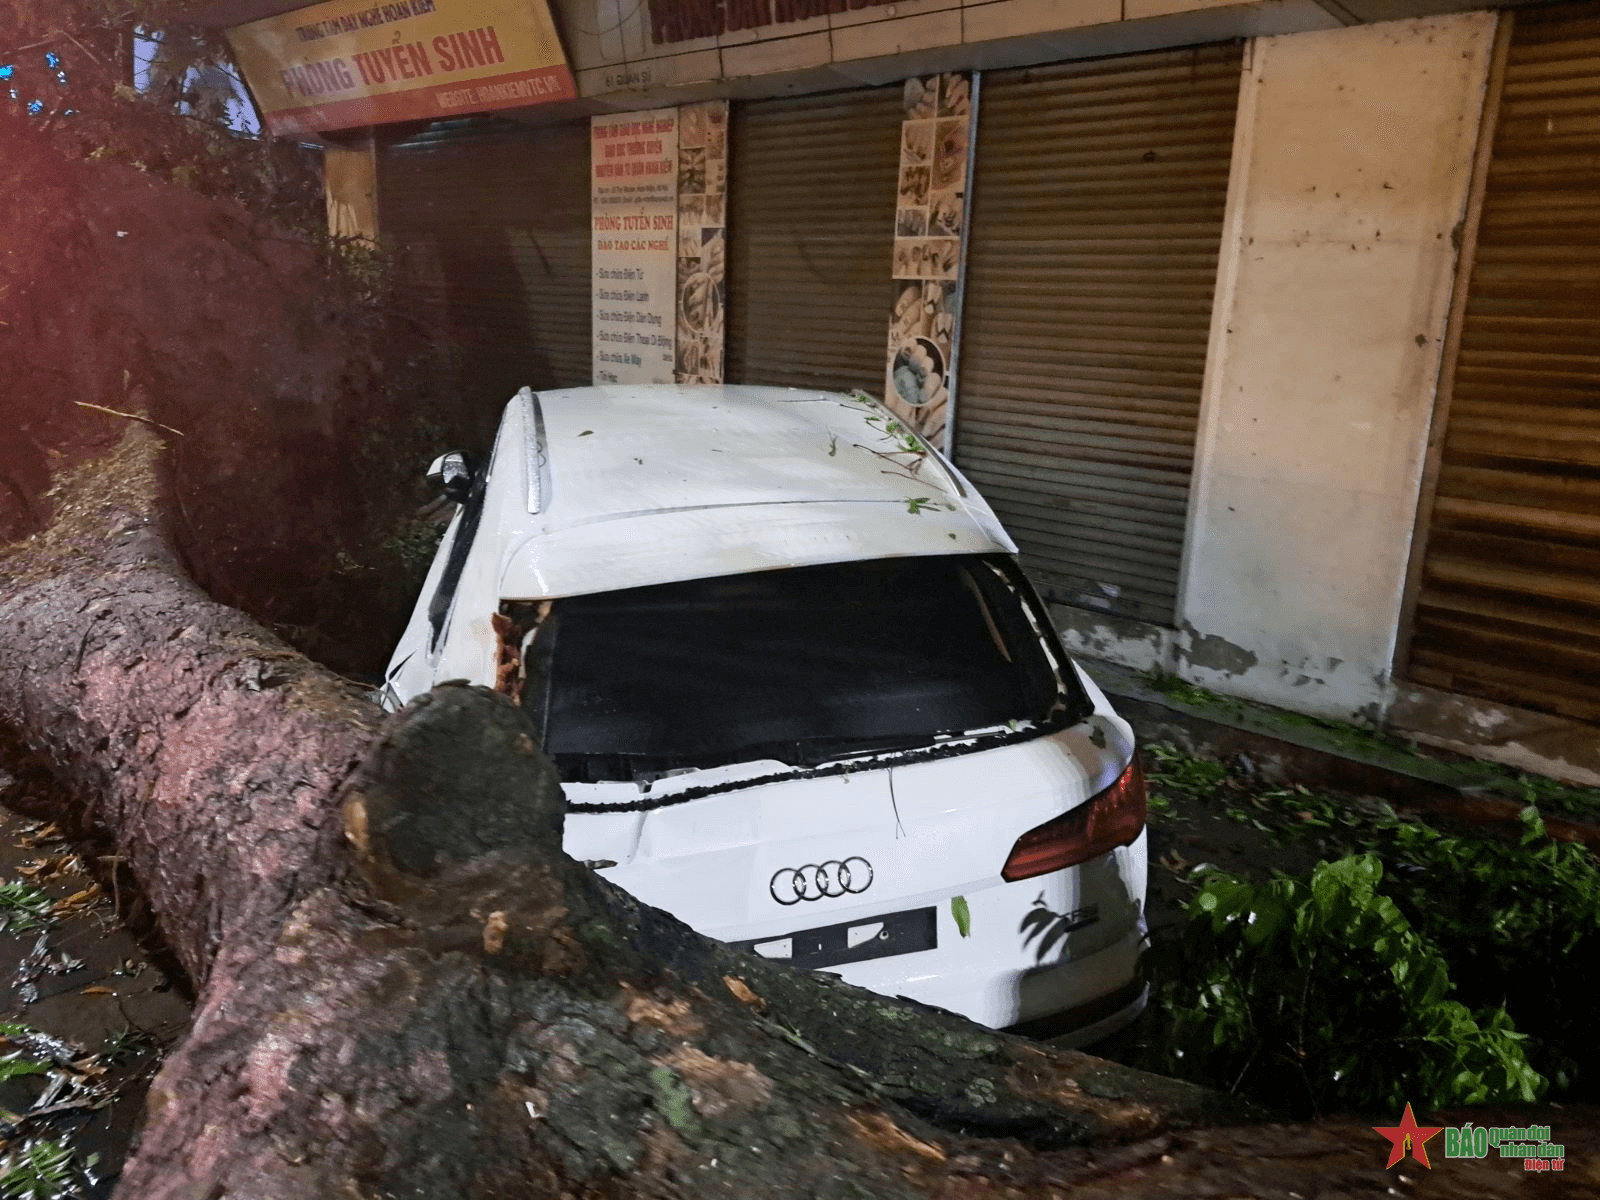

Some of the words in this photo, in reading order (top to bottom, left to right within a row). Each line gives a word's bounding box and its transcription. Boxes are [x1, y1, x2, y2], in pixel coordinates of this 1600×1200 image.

[279, 56, 356, 99] PHÒNG
[351, 30, 433, 85] TUYỂN
[432, 25, 505, 72] SINH
[594, 212, 622, 231] PHÒNG
[623, 206, 651, 231] TUYỂN
[652, 215, 674, 231] SINH
